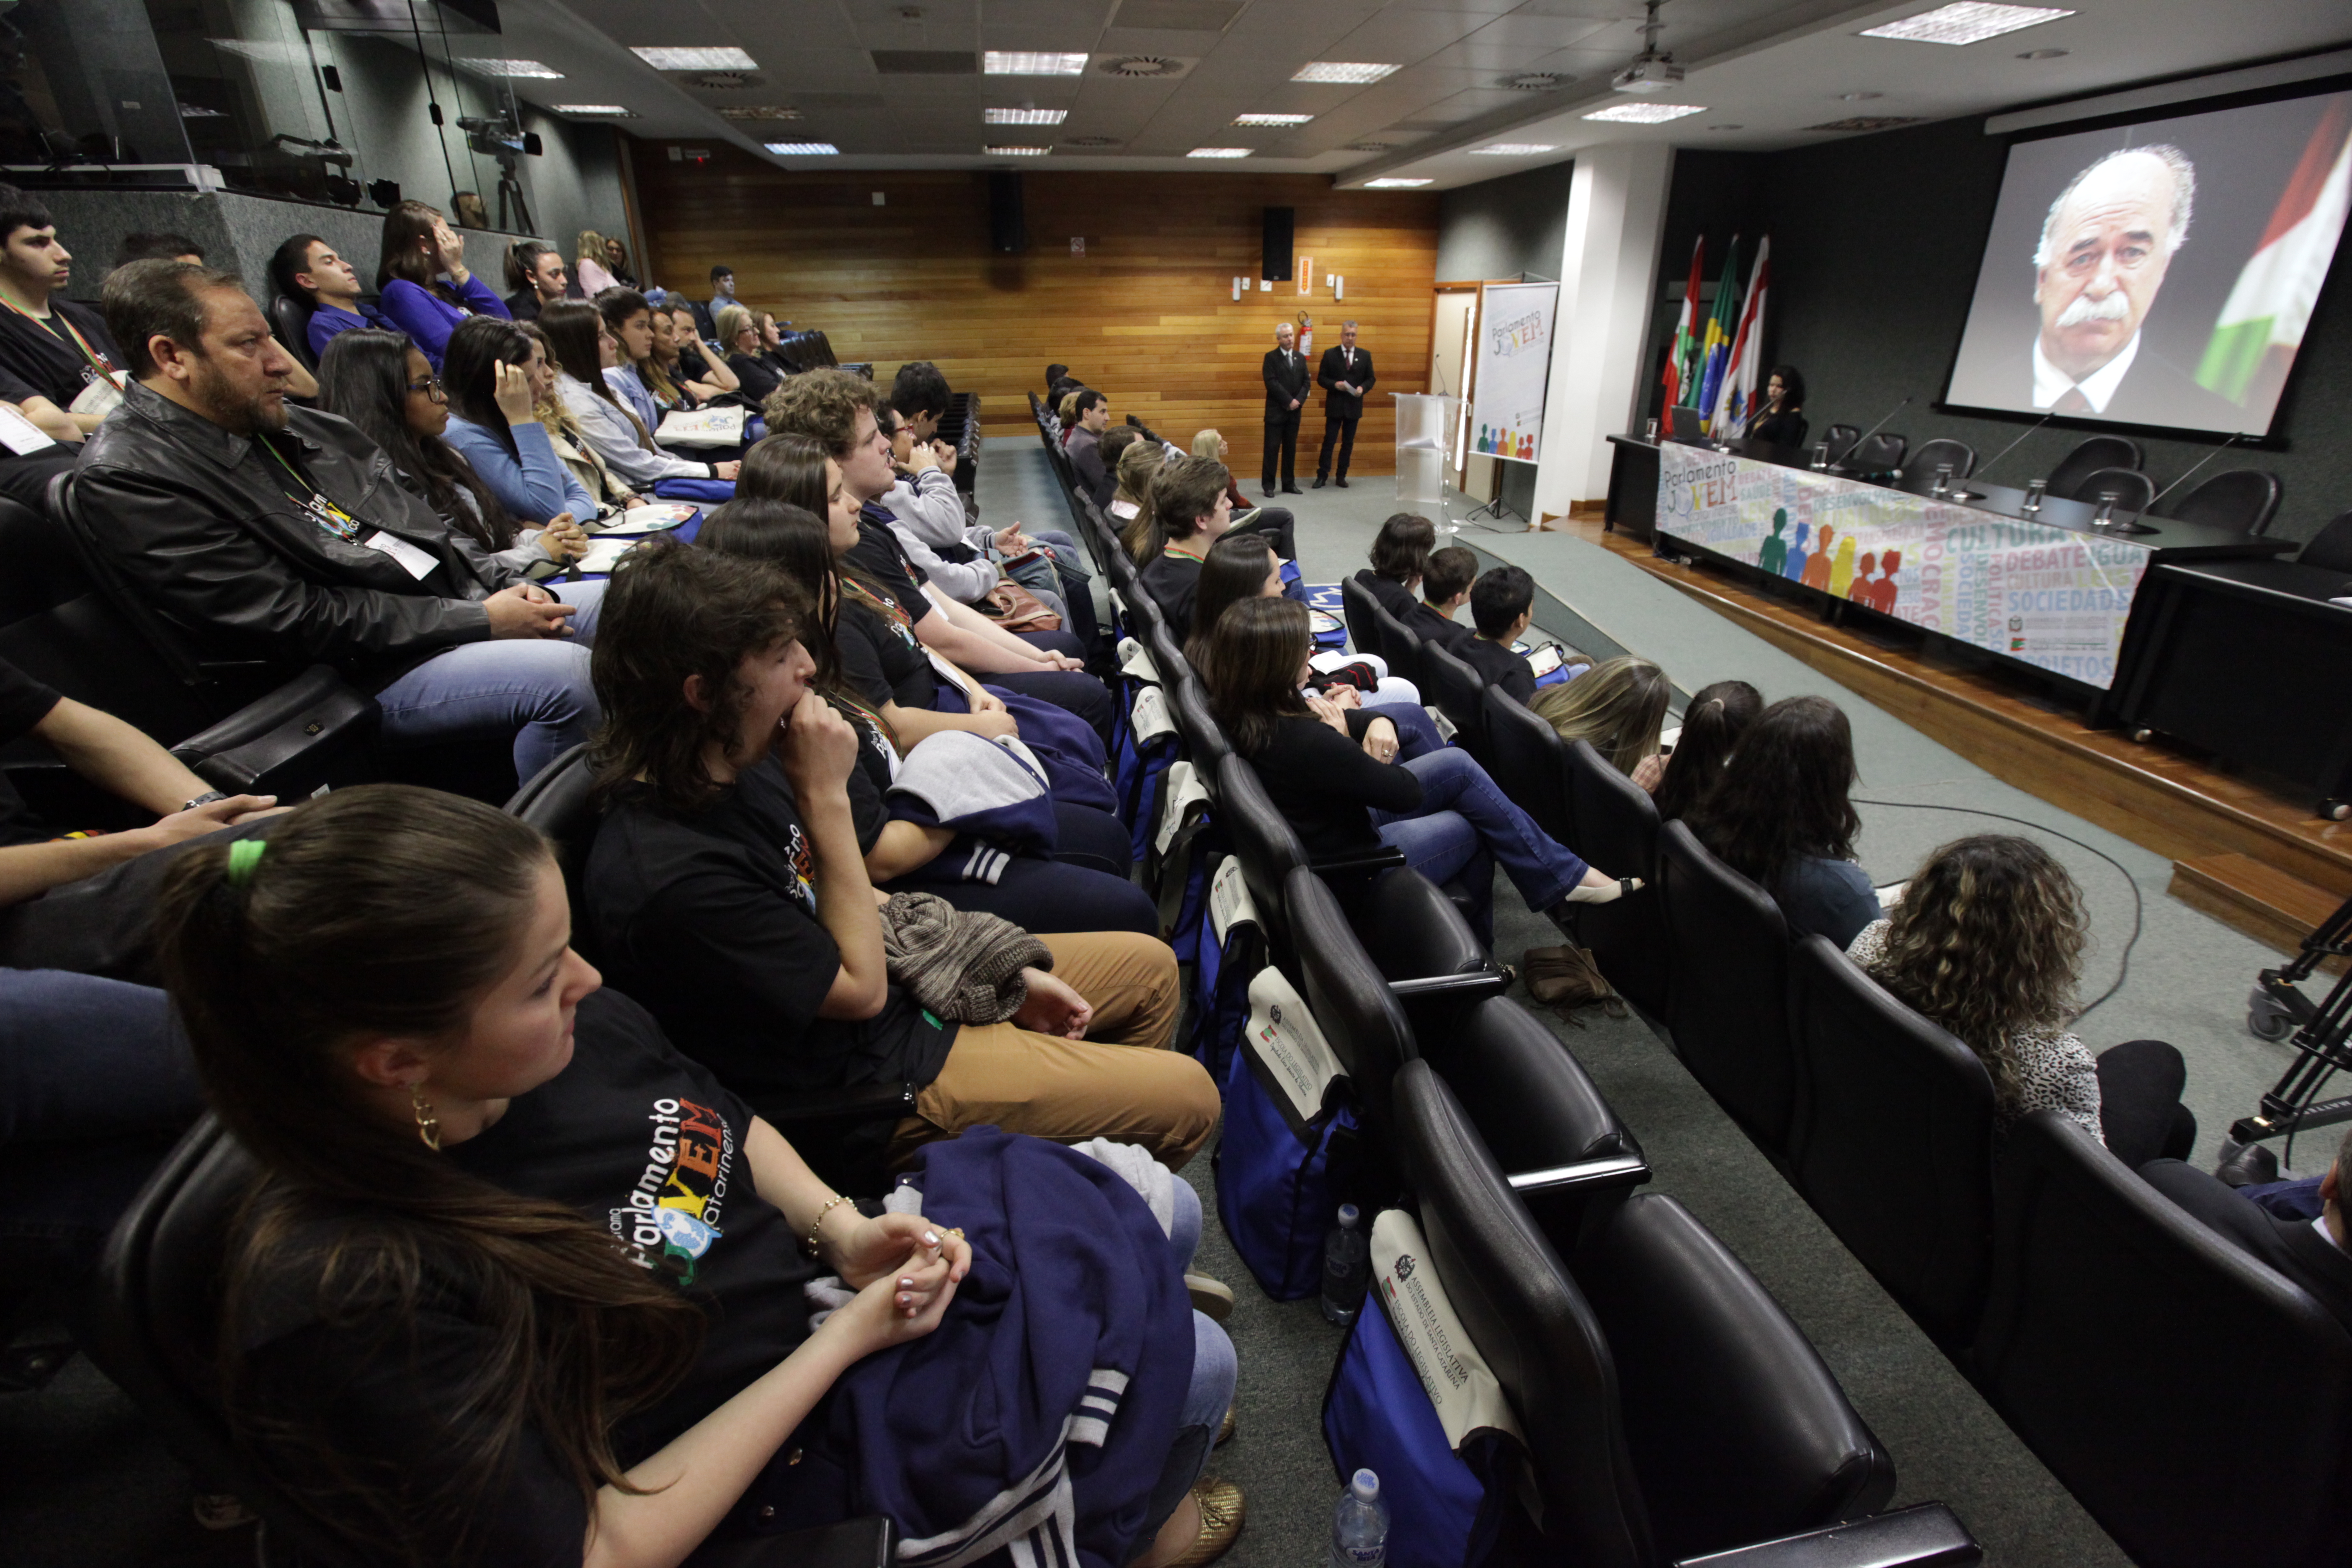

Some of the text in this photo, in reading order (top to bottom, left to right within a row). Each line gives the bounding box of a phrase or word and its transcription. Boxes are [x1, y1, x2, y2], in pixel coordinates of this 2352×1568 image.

[1492, 309, 1541, 340] Parlamento
[1493, 319, 1545, 356] JOVEM
[1664, 459, 1737, 489] Parlamento
[1667, 475, 1738, 513] JOVEM
[1947, 520, 2067, 554] CULTURA
[2006, 545, 2086, 573] DEBATE
[1274, 1036, 1313, 1091] ESCOLA DO LEGISLATIVO
[621, 1098, 681, 1270] Parlamento
[1405, 1282, 1461, 1390] DO ESTADO DE SANTA CATARINA
[1411, 1276, 1437, 1326] ASSEMBLEIA
[1435, 1323, 1470, 1383] LEGISLATIVA
[1395, 1299, 1411, 1334] ESCOLA
[1408, 1331, 1418, 1346] DO
[1413, 1343, 1443, 1405] LEGISLATIVO
